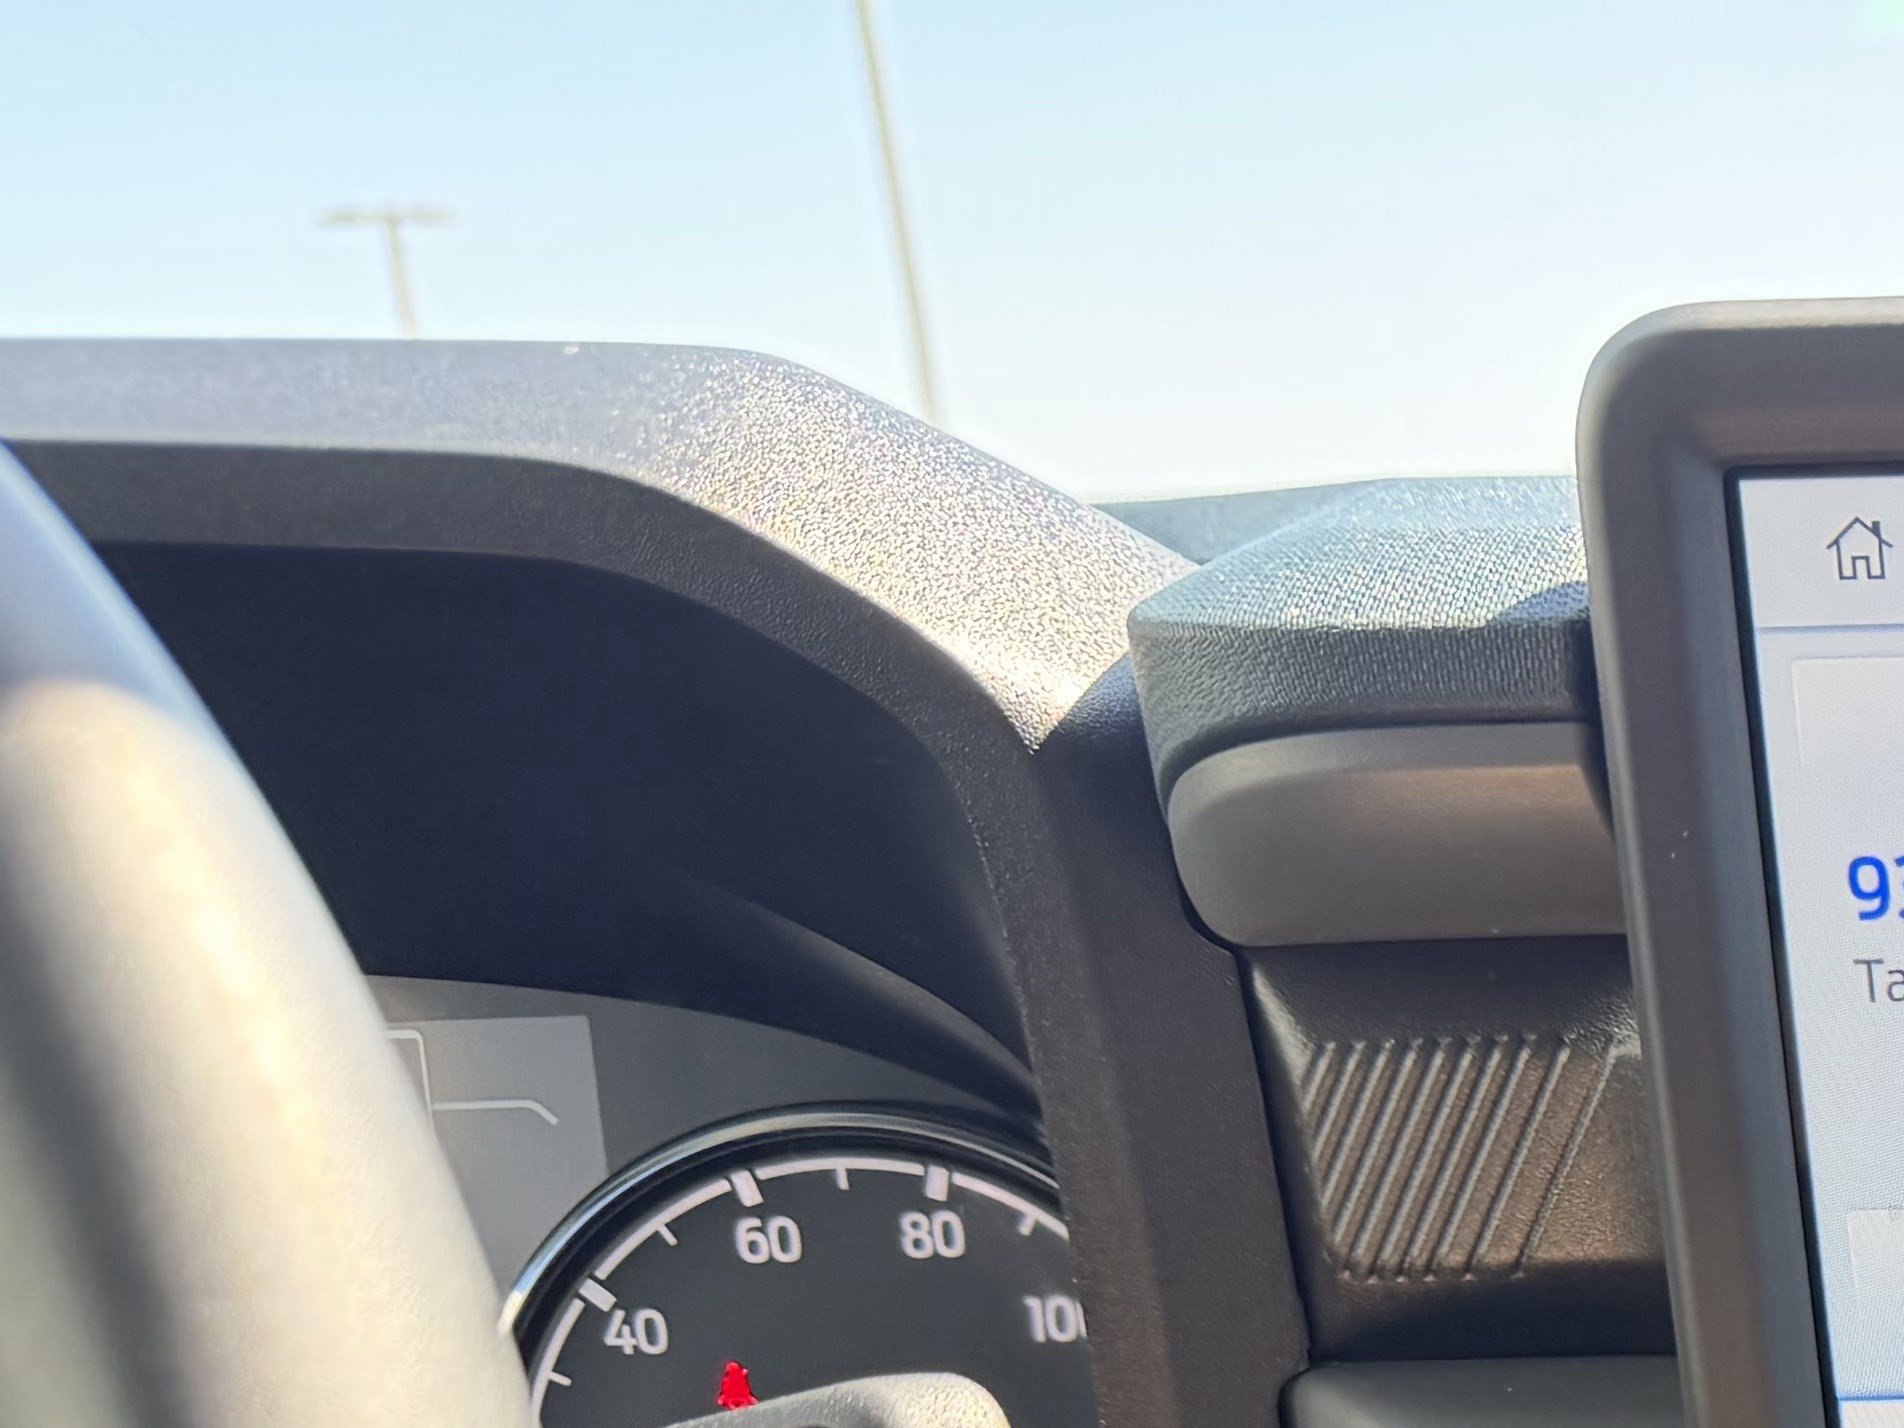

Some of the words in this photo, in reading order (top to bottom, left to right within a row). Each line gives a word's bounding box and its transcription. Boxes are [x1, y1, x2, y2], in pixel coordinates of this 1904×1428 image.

[734, 1214, 803, 1264] 60
[899, 1210, 967, 1260] 80
[603, 1308, 668, 1356] 40
